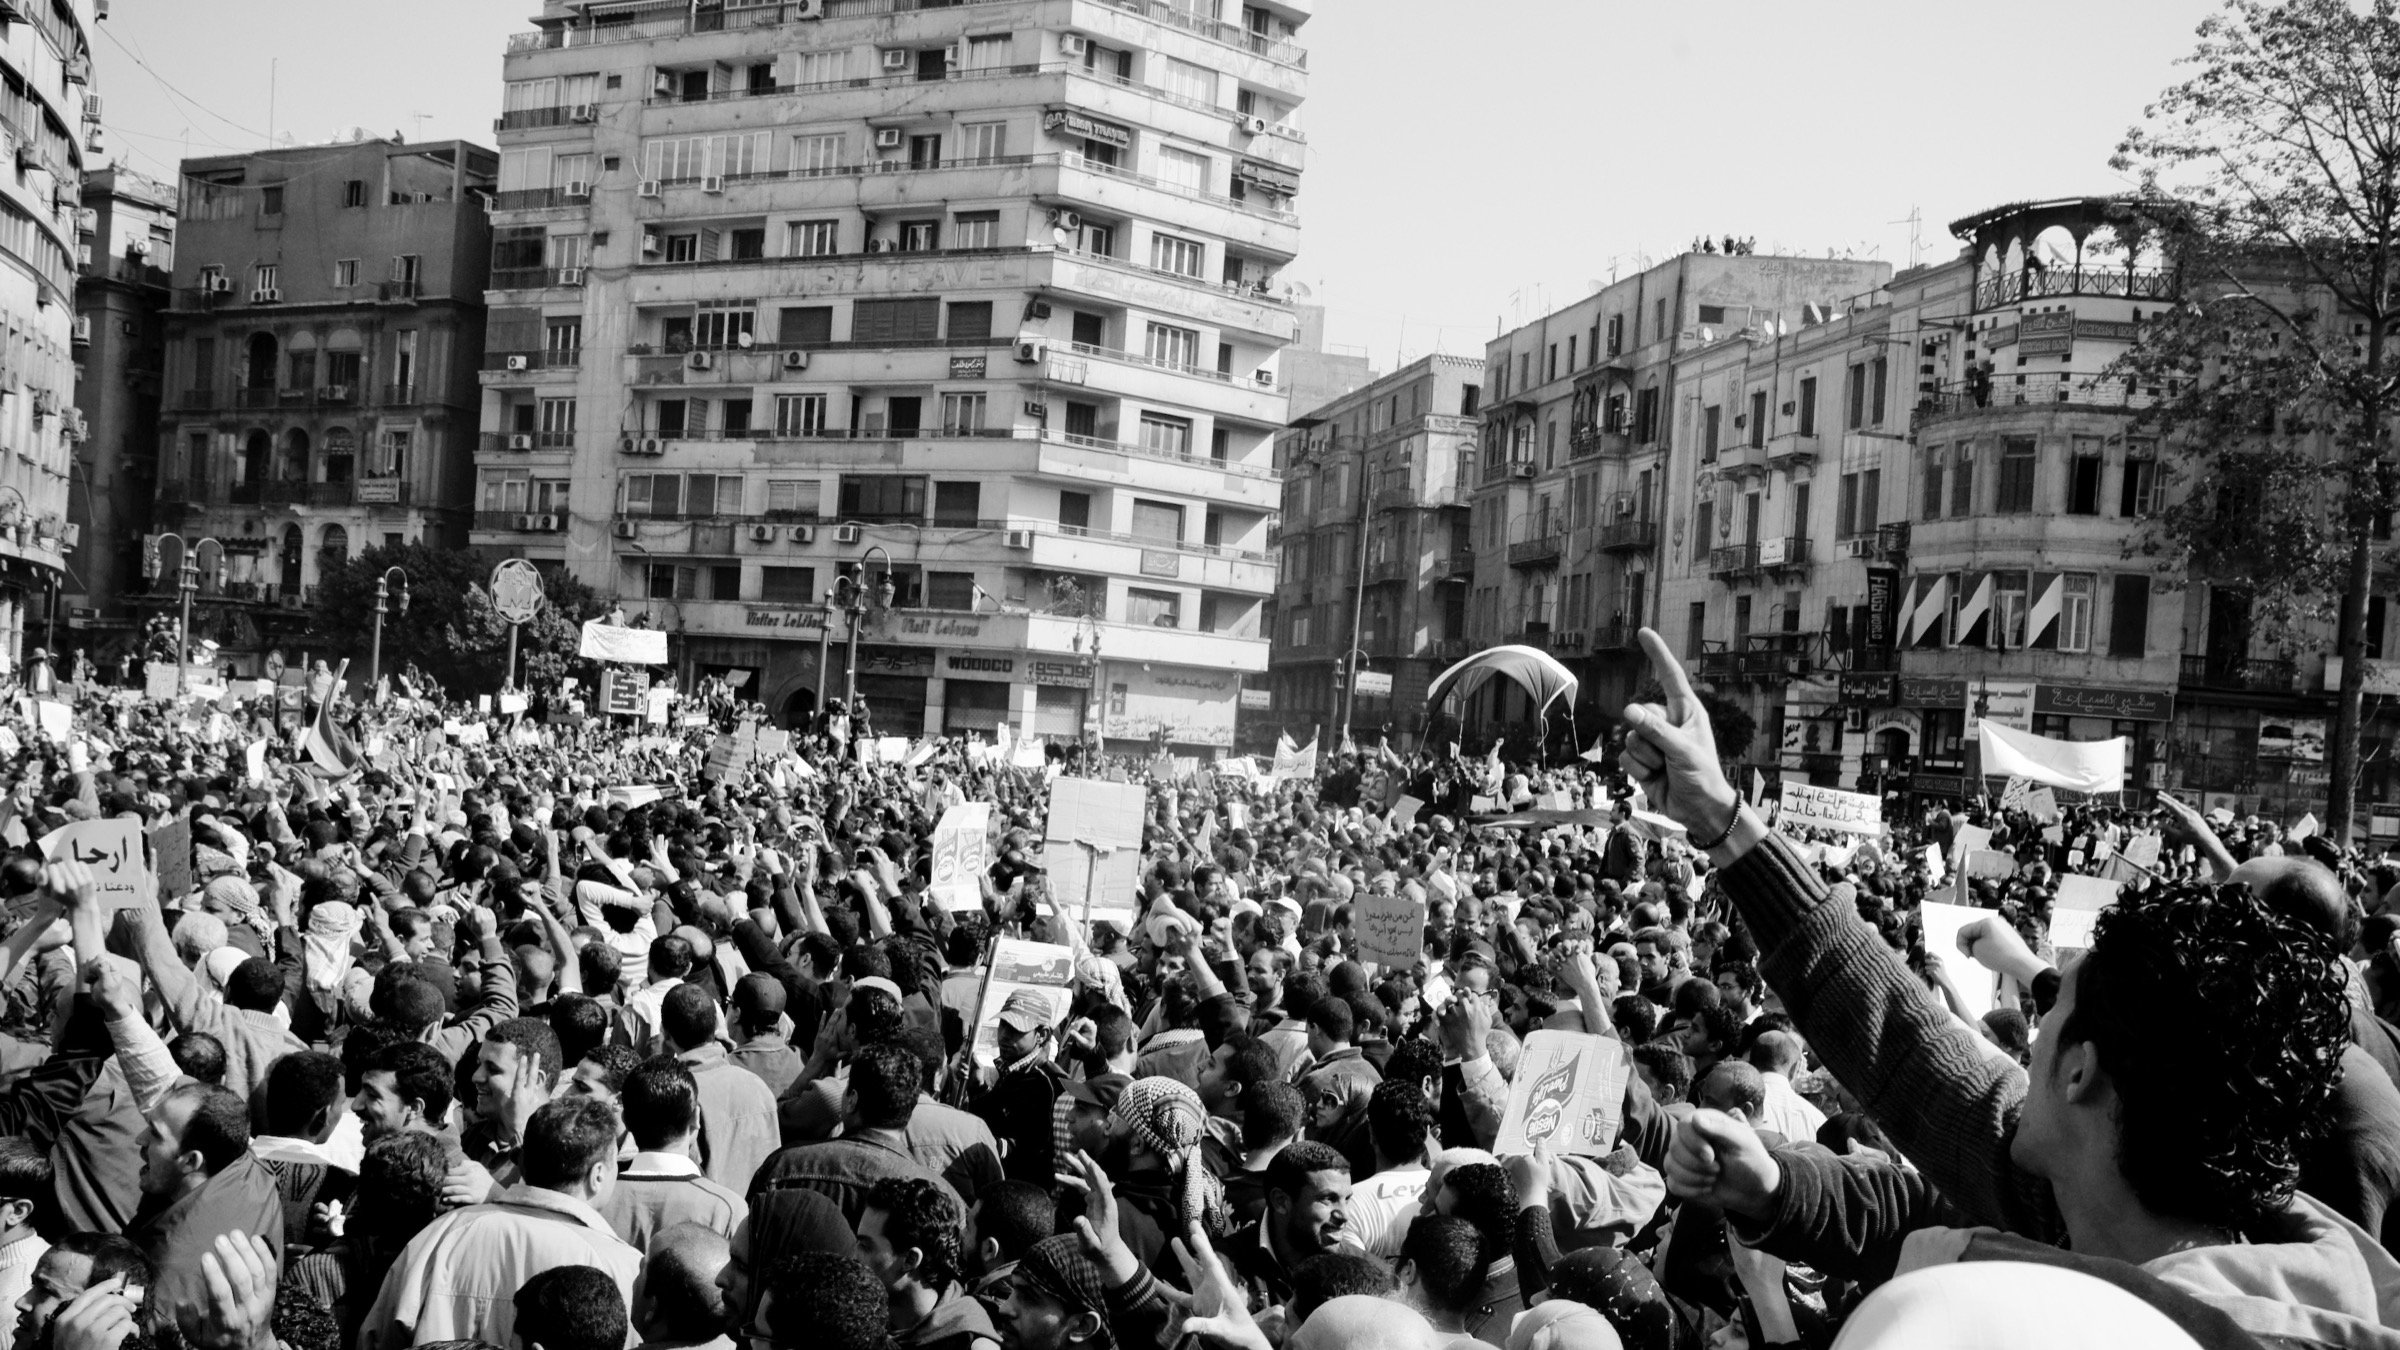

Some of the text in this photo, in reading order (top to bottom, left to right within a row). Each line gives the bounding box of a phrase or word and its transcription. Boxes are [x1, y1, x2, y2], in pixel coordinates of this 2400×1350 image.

[1870, 576, 1888, 612] FLAGS
[948, 656, 1013, 673] WOODCO
[2052, 687, 2116, 713] للسياحة
[1546, 1071, 1570, 1094] Pure
